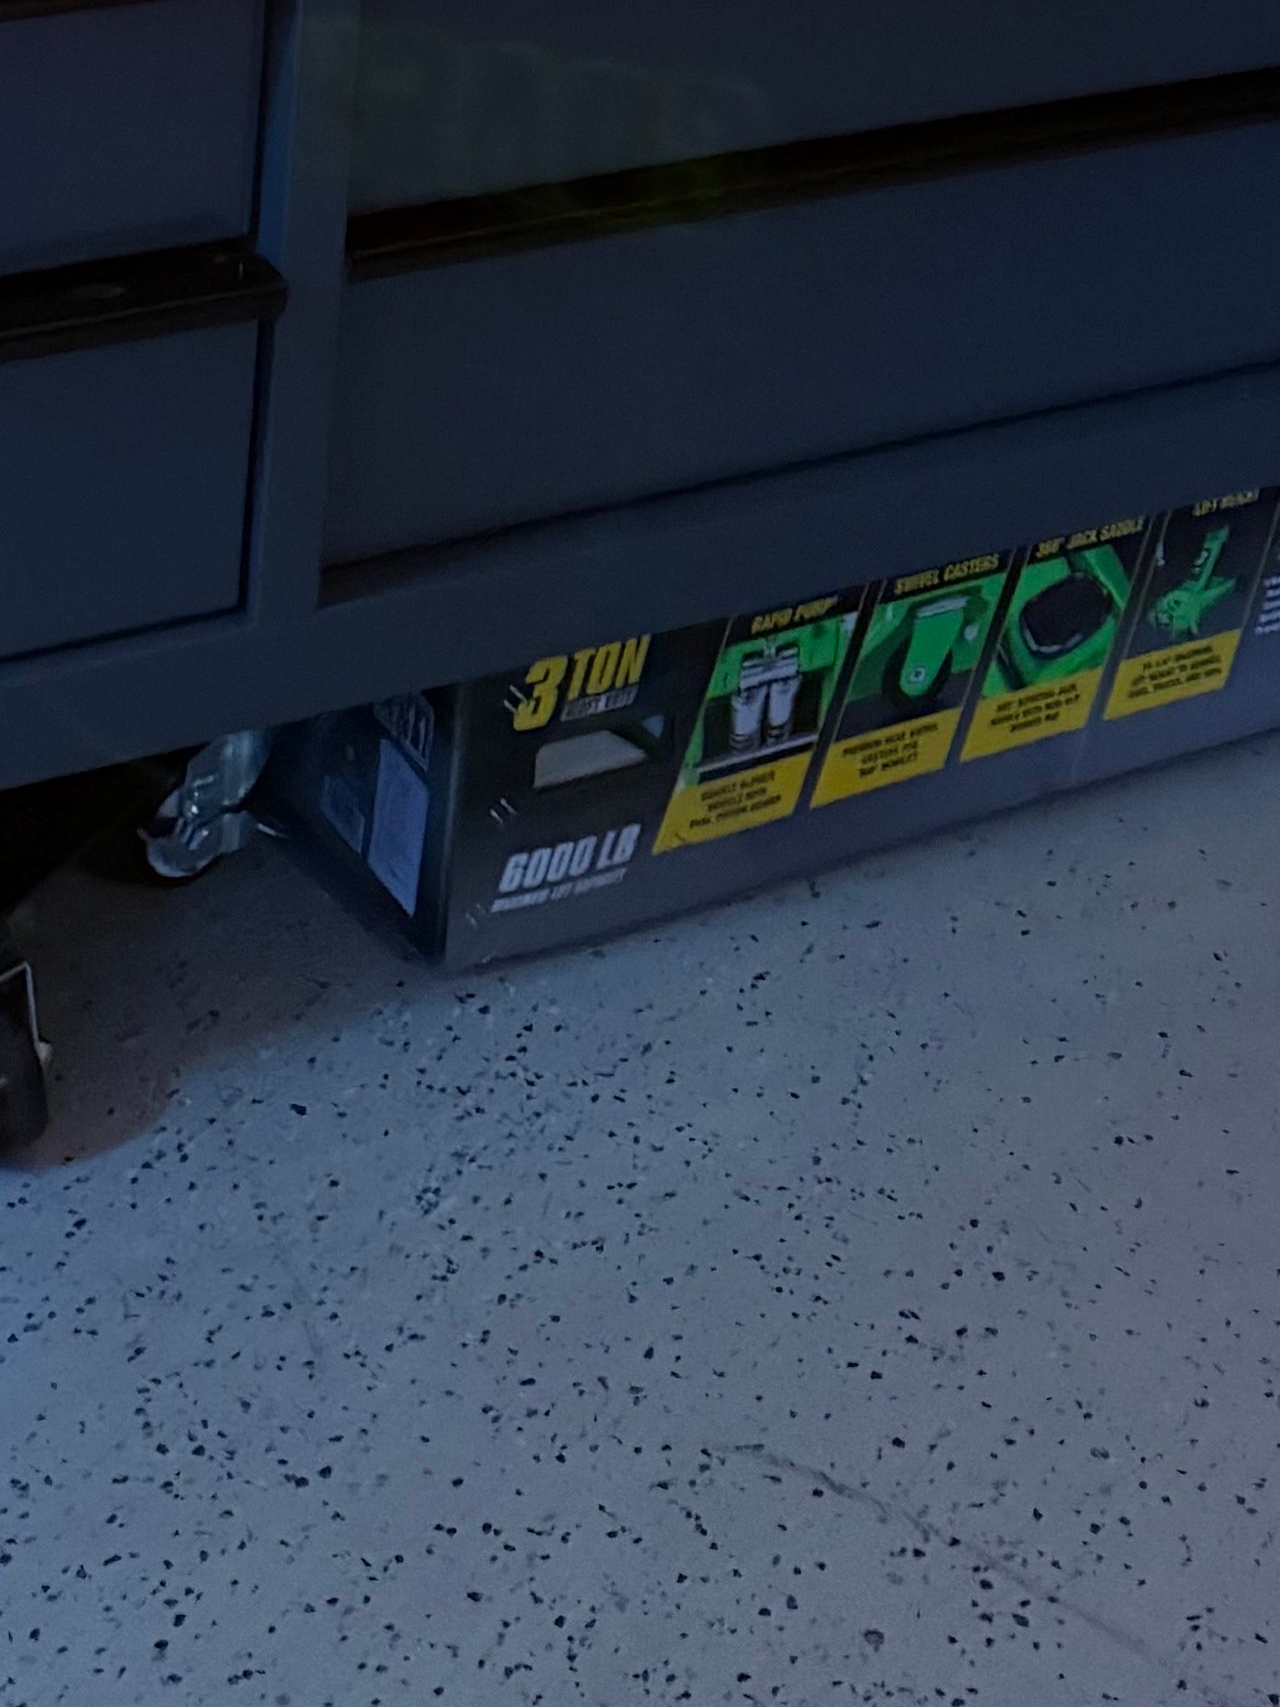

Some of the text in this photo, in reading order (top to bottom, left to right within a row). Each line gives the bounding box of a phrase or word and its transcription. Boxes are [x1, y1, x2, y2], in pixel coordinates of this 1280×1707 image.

[513, 655, 569, 732] 3
[568, 634, 652, 702] TON
[497, 835, 598, 894] 6000
[596, 822, 642, 871] LB
